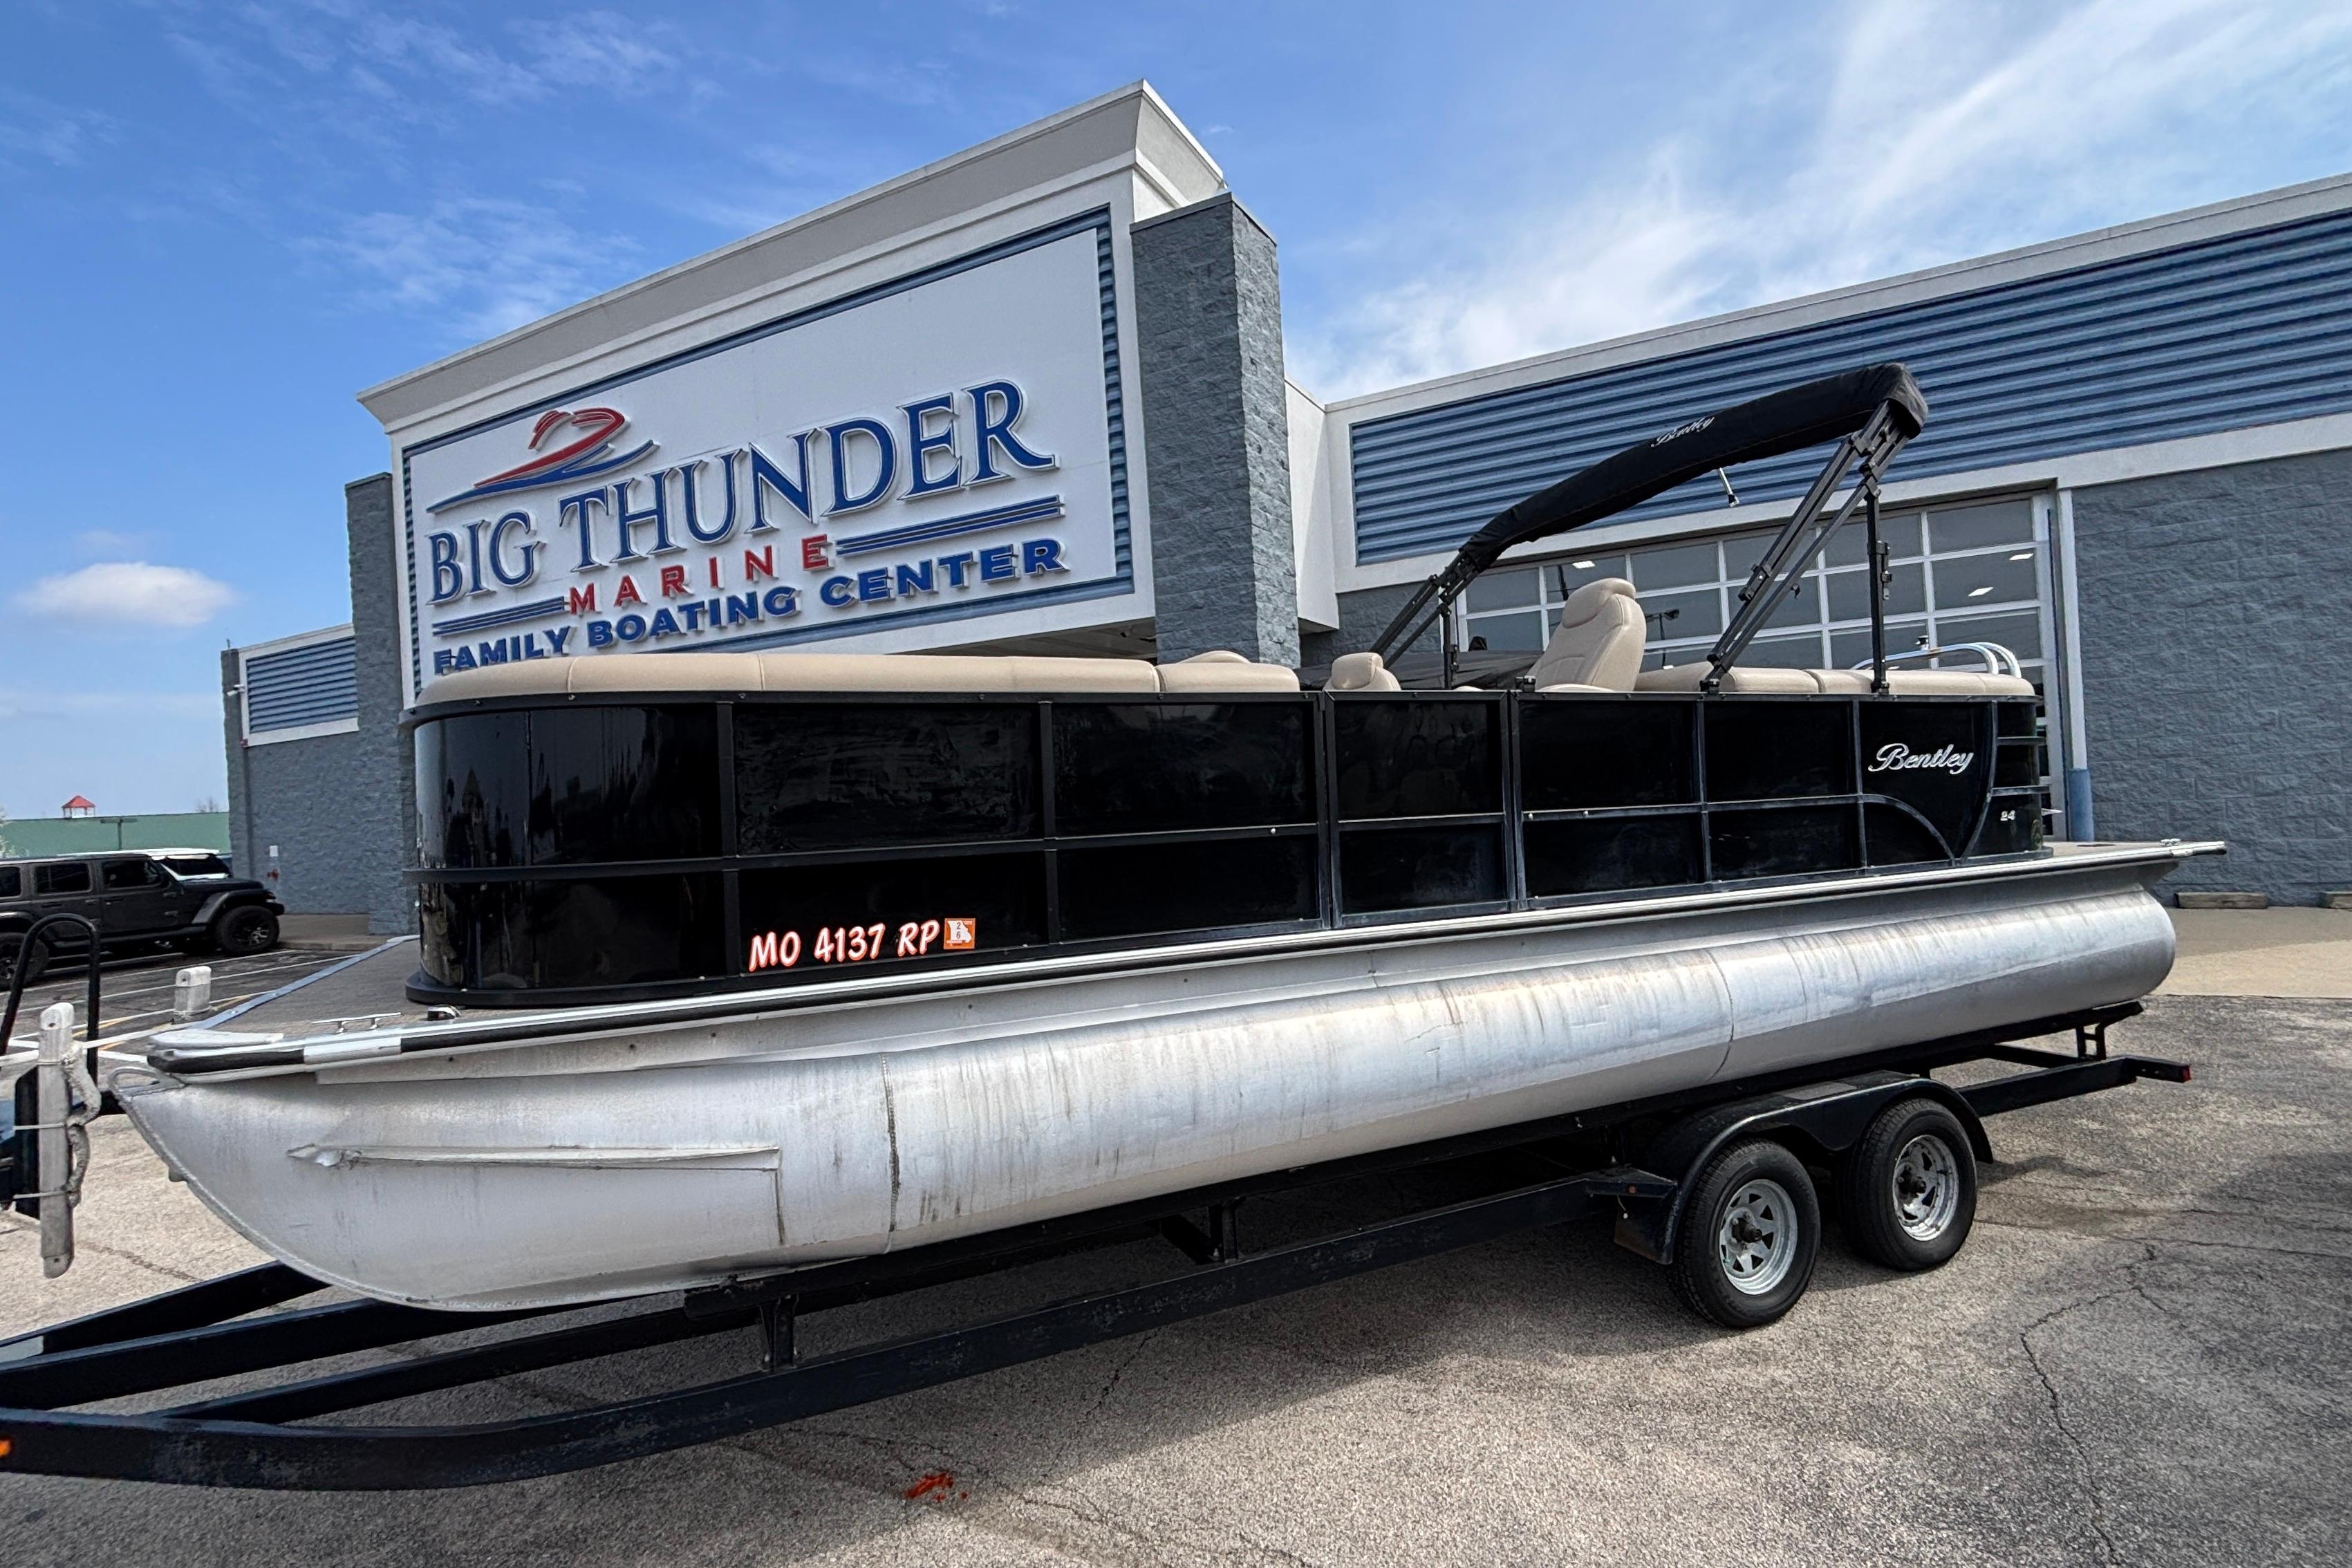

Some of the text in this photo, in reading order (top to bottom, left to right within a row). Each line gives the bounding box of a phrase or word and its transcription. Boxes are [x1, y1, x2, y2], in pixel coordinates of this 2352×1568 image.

[425, 378, 1058, 606] BIG THUNDER
[433, 538, 1067, 675] FAMILY BOATING CENTER
[569, 534, 831, 615] MARINE
[1868, 743, 1974, 774] Bentley
[749, 920, 940, 972] MO 4137 RP
